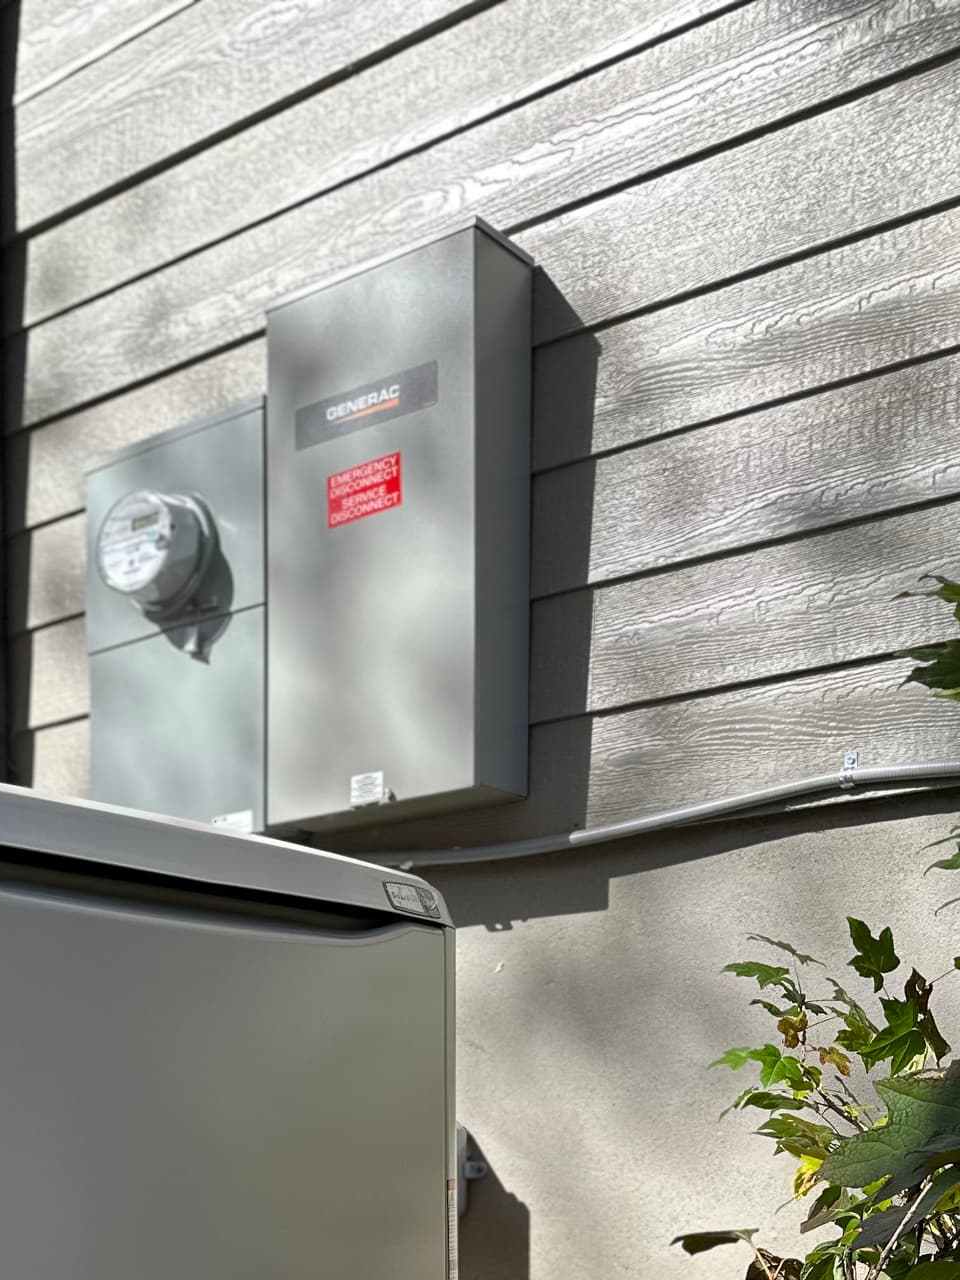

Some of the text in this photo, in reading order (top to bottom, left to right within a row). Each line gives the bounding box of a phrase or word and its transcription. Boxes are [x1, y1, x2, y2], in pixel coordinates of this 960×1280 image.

[326, 385, 400, 420] GENERAC
[330, 456, 397, 486] EMERGENCY
[330, 468, 398, 499] DISCONNECT
[330, 493, 399, 524] DISCONNECT
[341, 485, 387, 509] SERVICE
